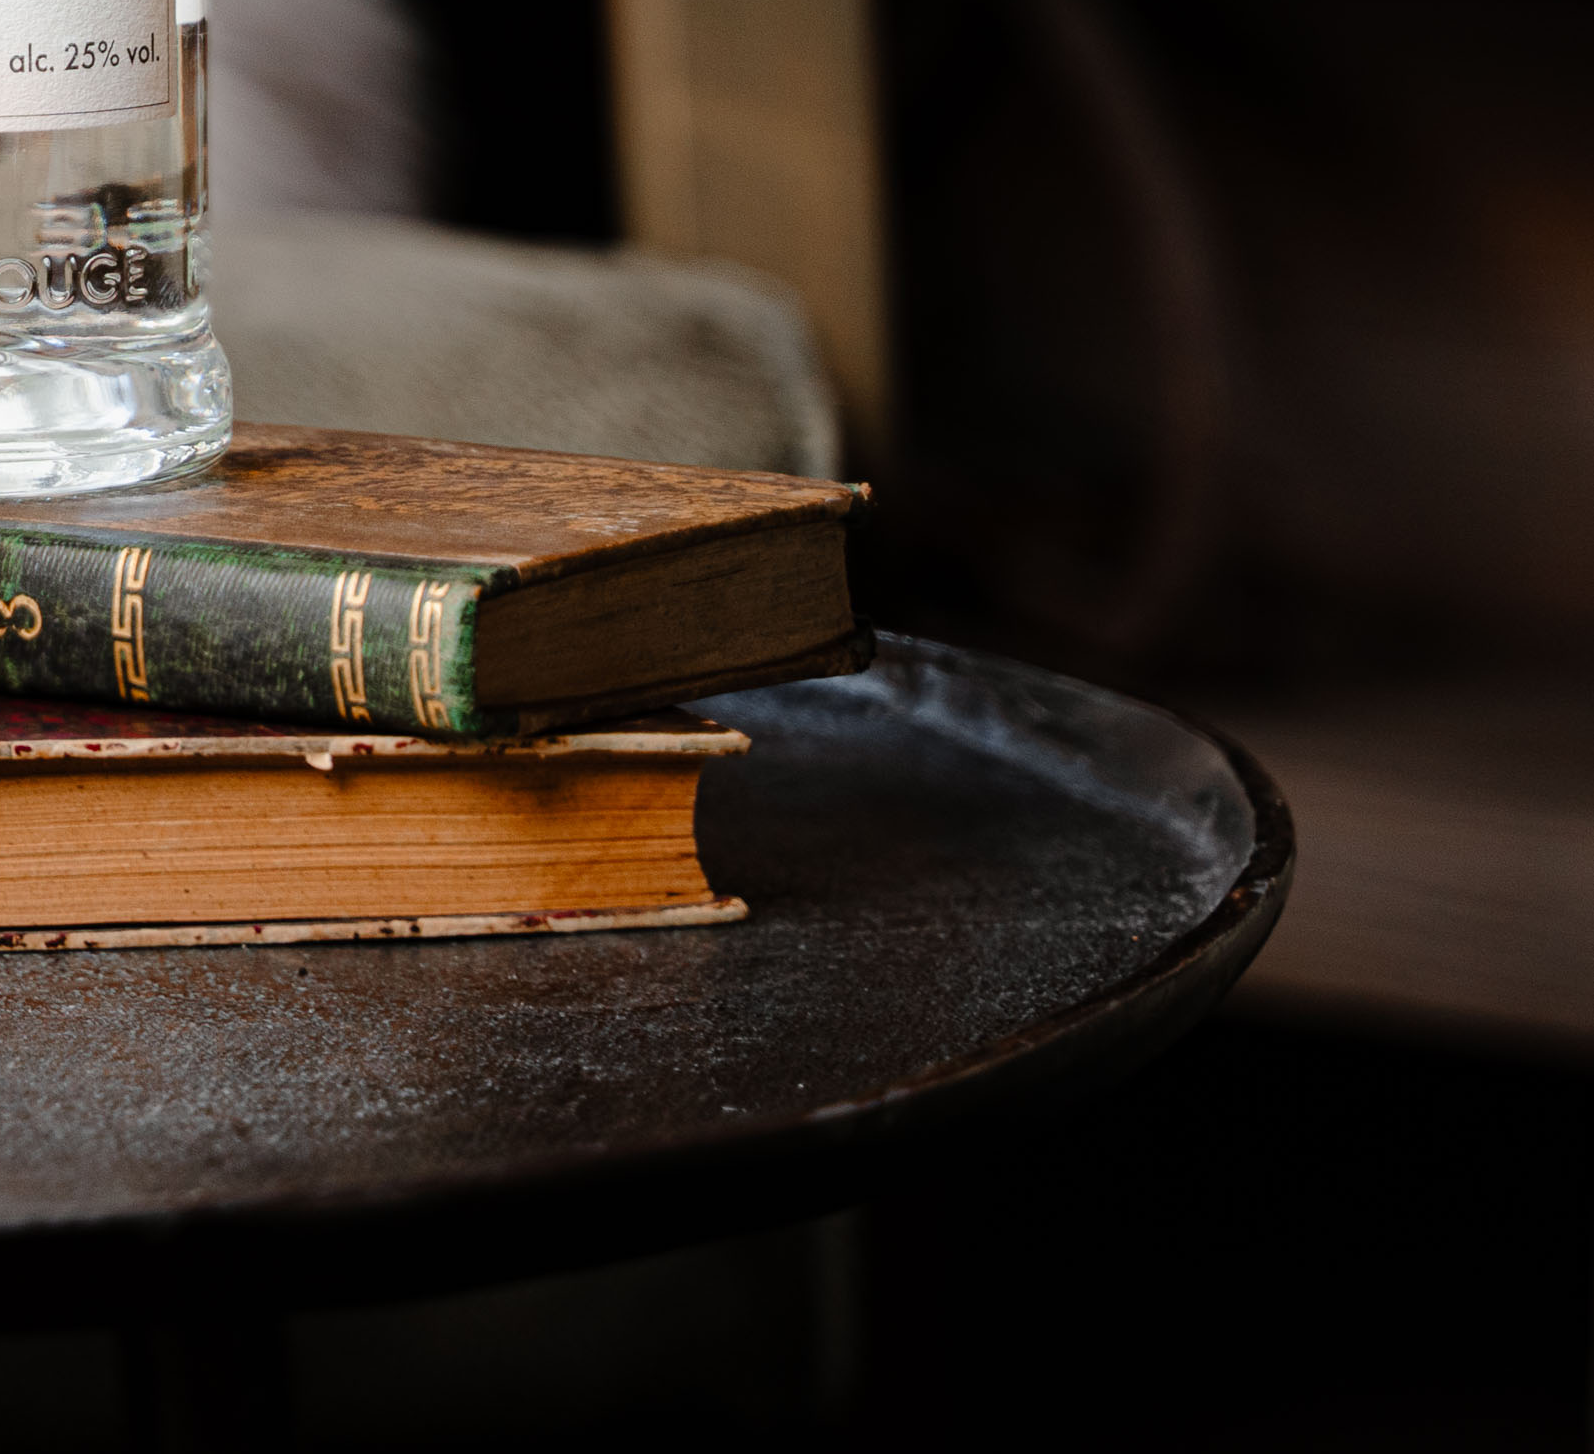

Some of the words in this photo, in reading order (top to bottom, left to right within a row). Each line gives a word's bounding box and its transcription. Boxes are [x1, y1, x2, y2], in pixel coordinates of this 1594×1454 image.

[9, 43, 55, 73] alc.
[64, 40, 120, 71] 25%
[126, 32, 160, 65] vol.
